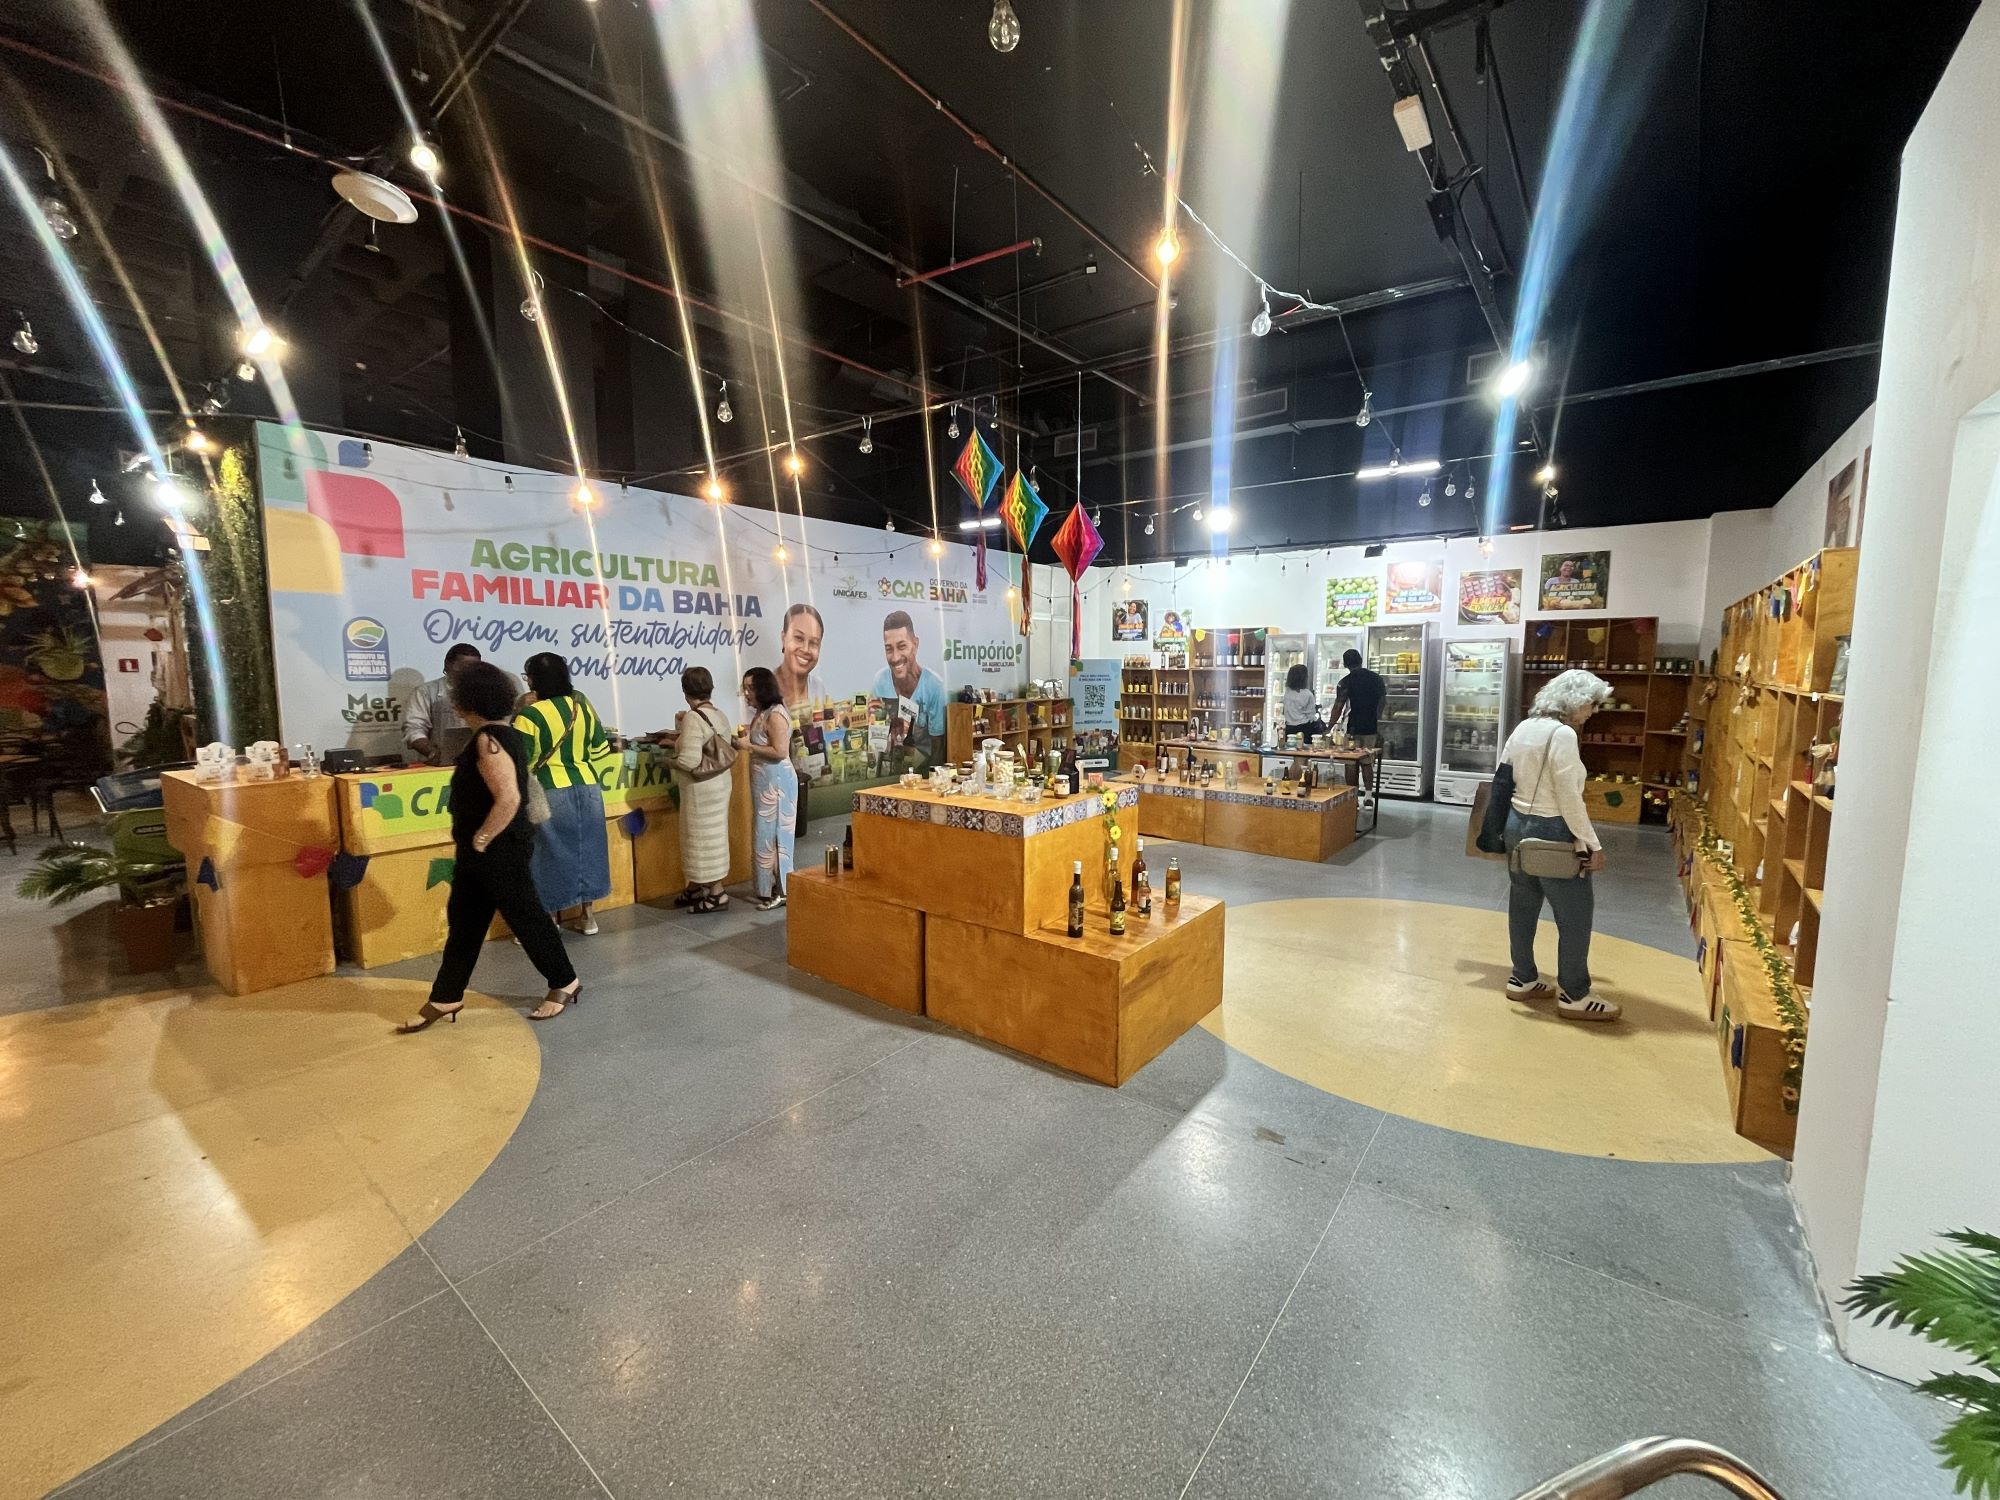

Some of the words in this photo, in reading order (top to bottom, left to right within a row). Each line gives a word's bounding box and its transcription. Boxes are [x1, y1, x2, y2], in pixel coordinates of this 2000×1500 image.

[470, 538, 721, 588] AGRICULTURA
[411, 568, 610, 610] FAMILIAR
[618, 586, 665, 613] DA
[672, 590, 763, 618] BAHIA
[833, 589, 868, 599] UNICAFES
[892, 579, 925, 599] CAR
[423, 608, 560, 652] Origem,
[570, 619, 760, 655] sustentabilidade
[953, 639, 1015, 665] Empório
